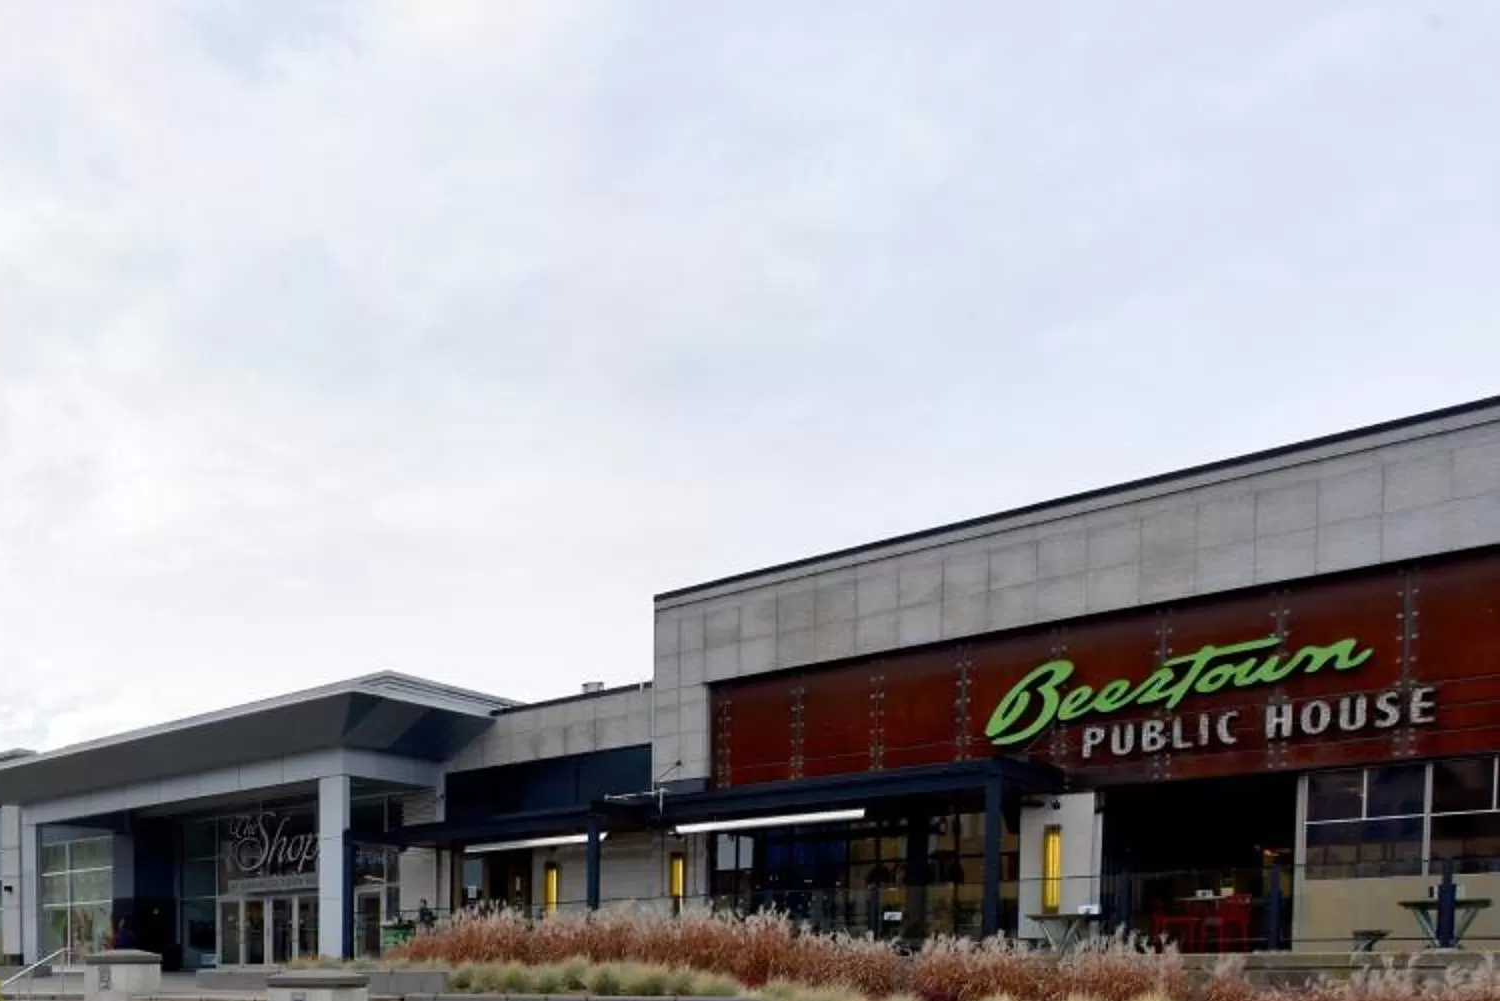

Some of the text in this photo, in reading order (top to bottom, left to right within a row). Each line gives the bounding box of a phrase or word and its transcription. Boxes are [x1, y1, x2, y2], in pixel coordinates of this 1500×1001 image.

[984, 636, 1374, 746] Beertown
[1081, 686, 1437, 759] PUBLIC HOUSE
